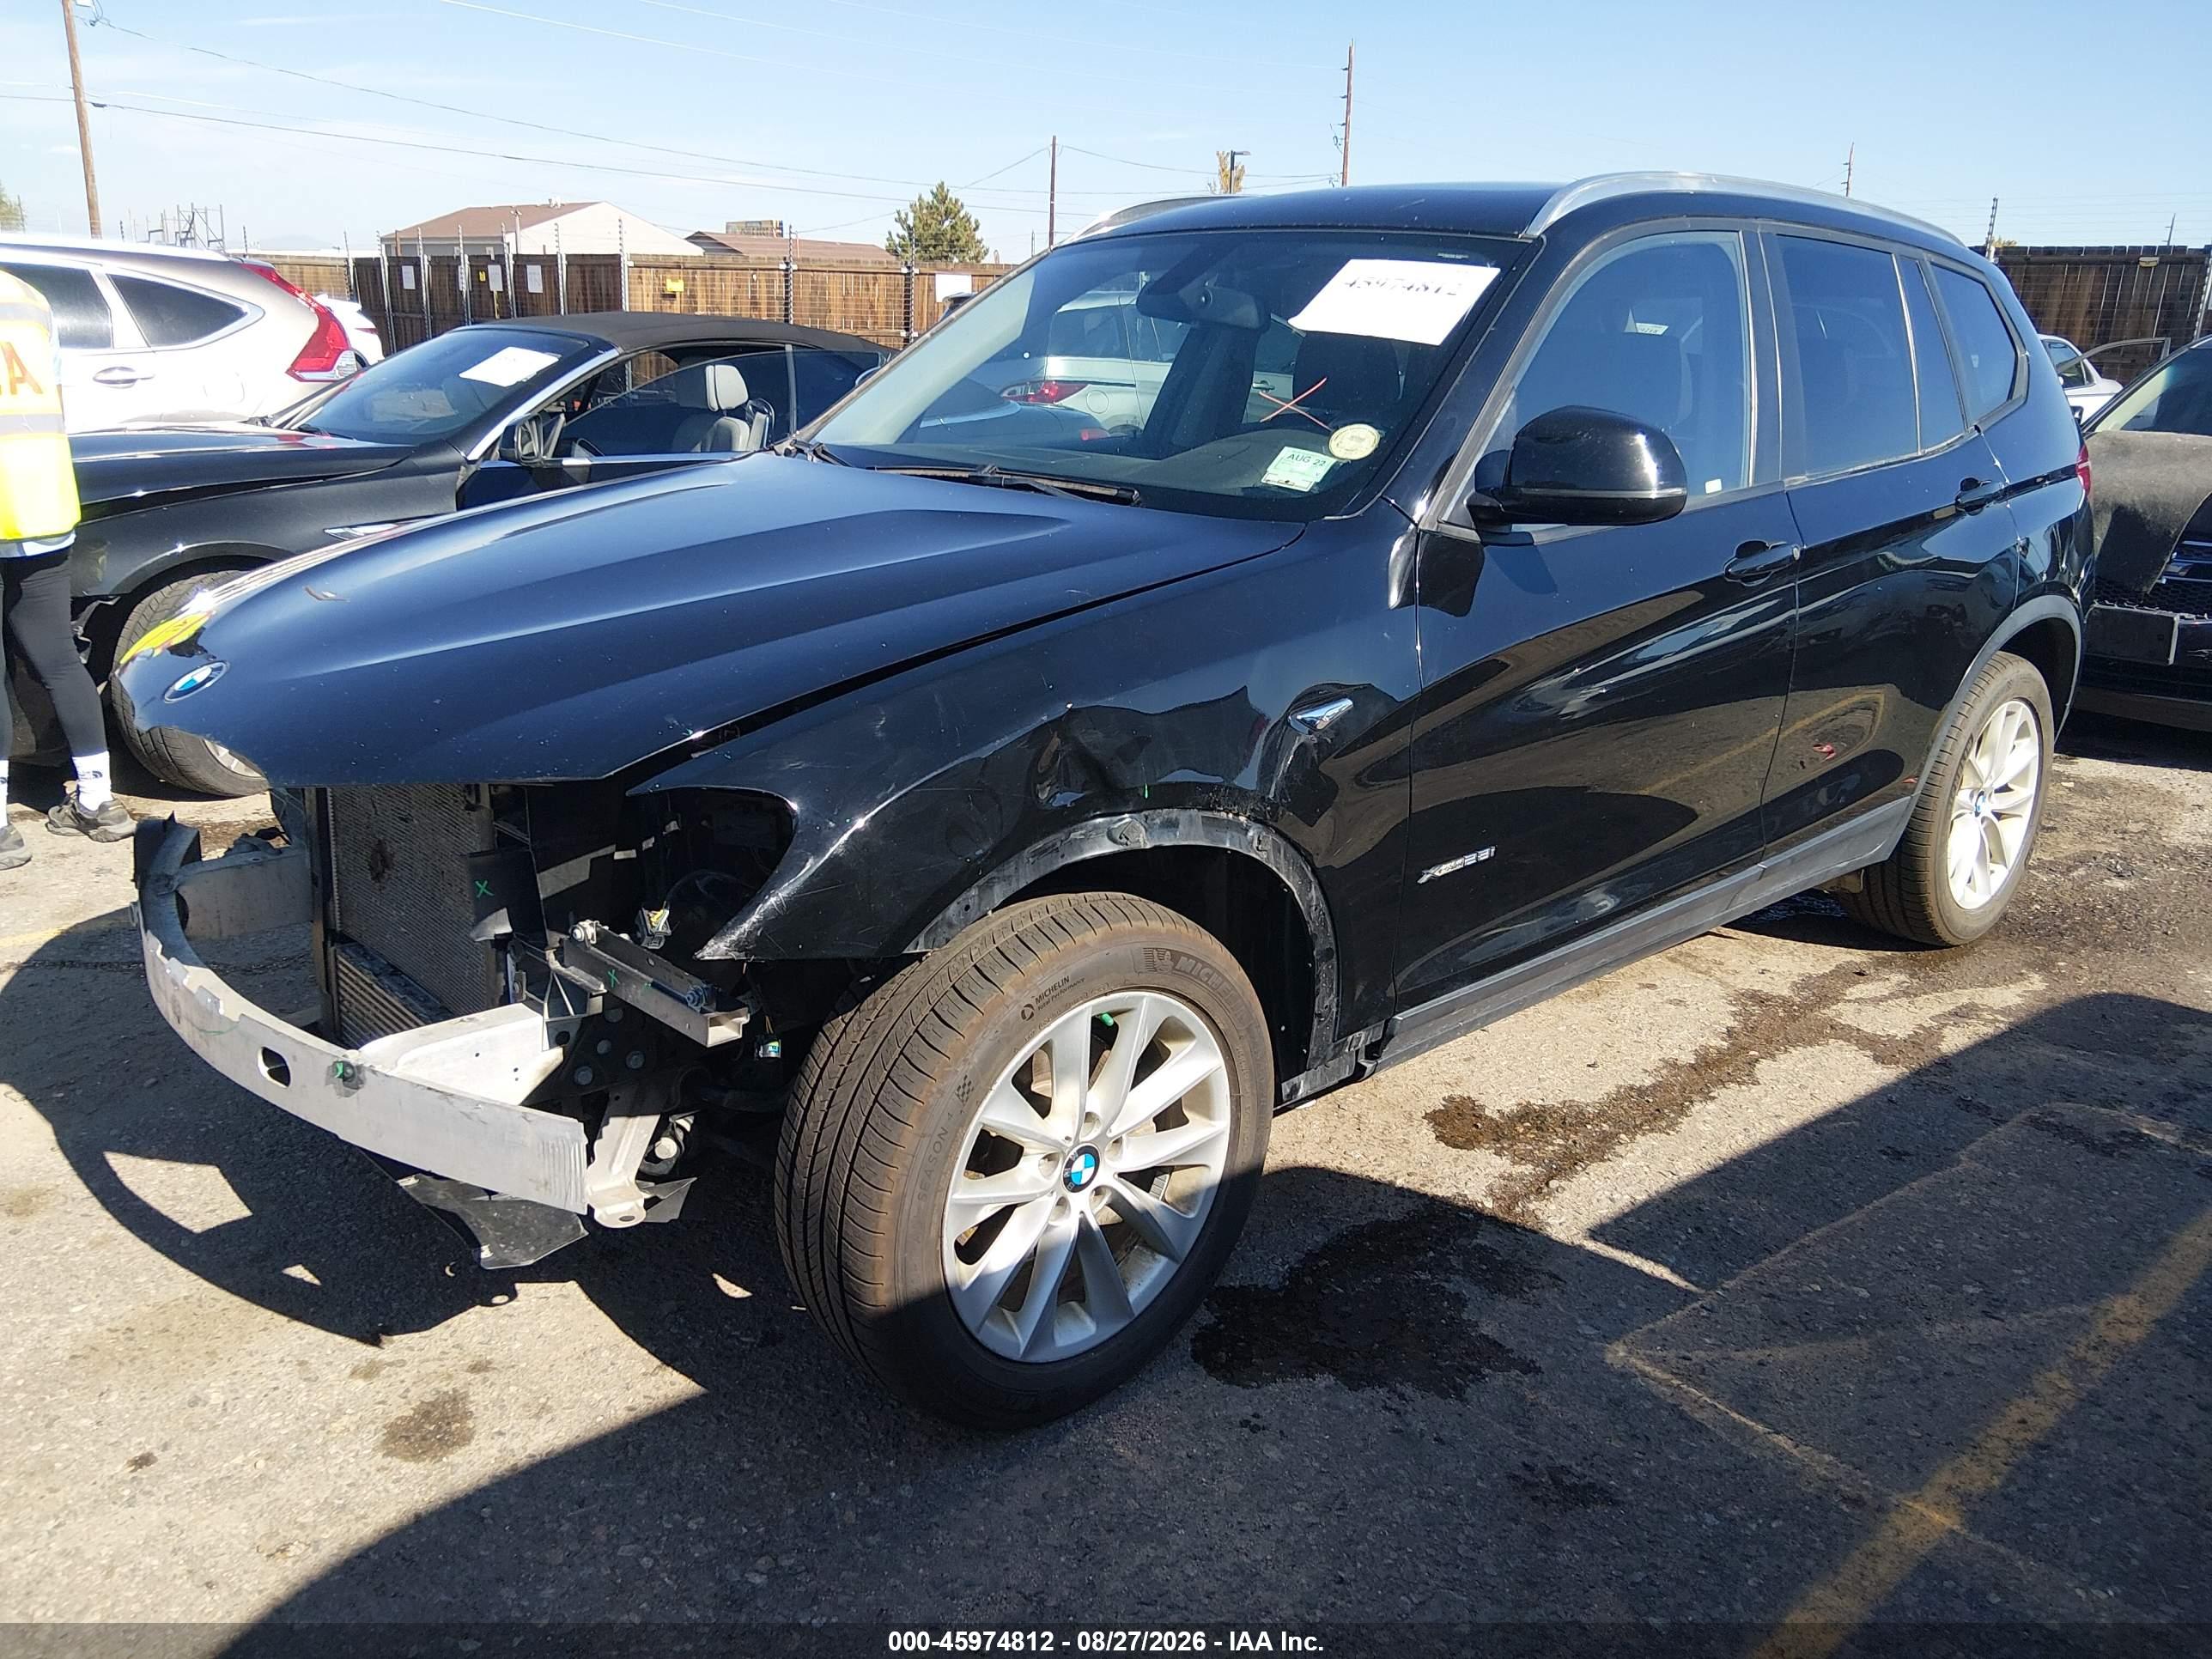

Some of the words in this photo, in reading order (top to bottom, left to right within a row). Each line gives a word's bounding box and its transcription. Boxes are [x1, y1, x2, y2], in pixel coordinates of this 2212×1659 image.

[0, 341, 43, 395] A
[1286, 453, 1312, 464] AUG
[1312, 459, 1327, 467] 22
[1035, 975, 1070, 1005] MICHELIN
[1037, 999, 1051, 1011] Total
[1175, 955, 1248, 1025] MICHELIN
[917, 1127, 949, 1203] SEASON
